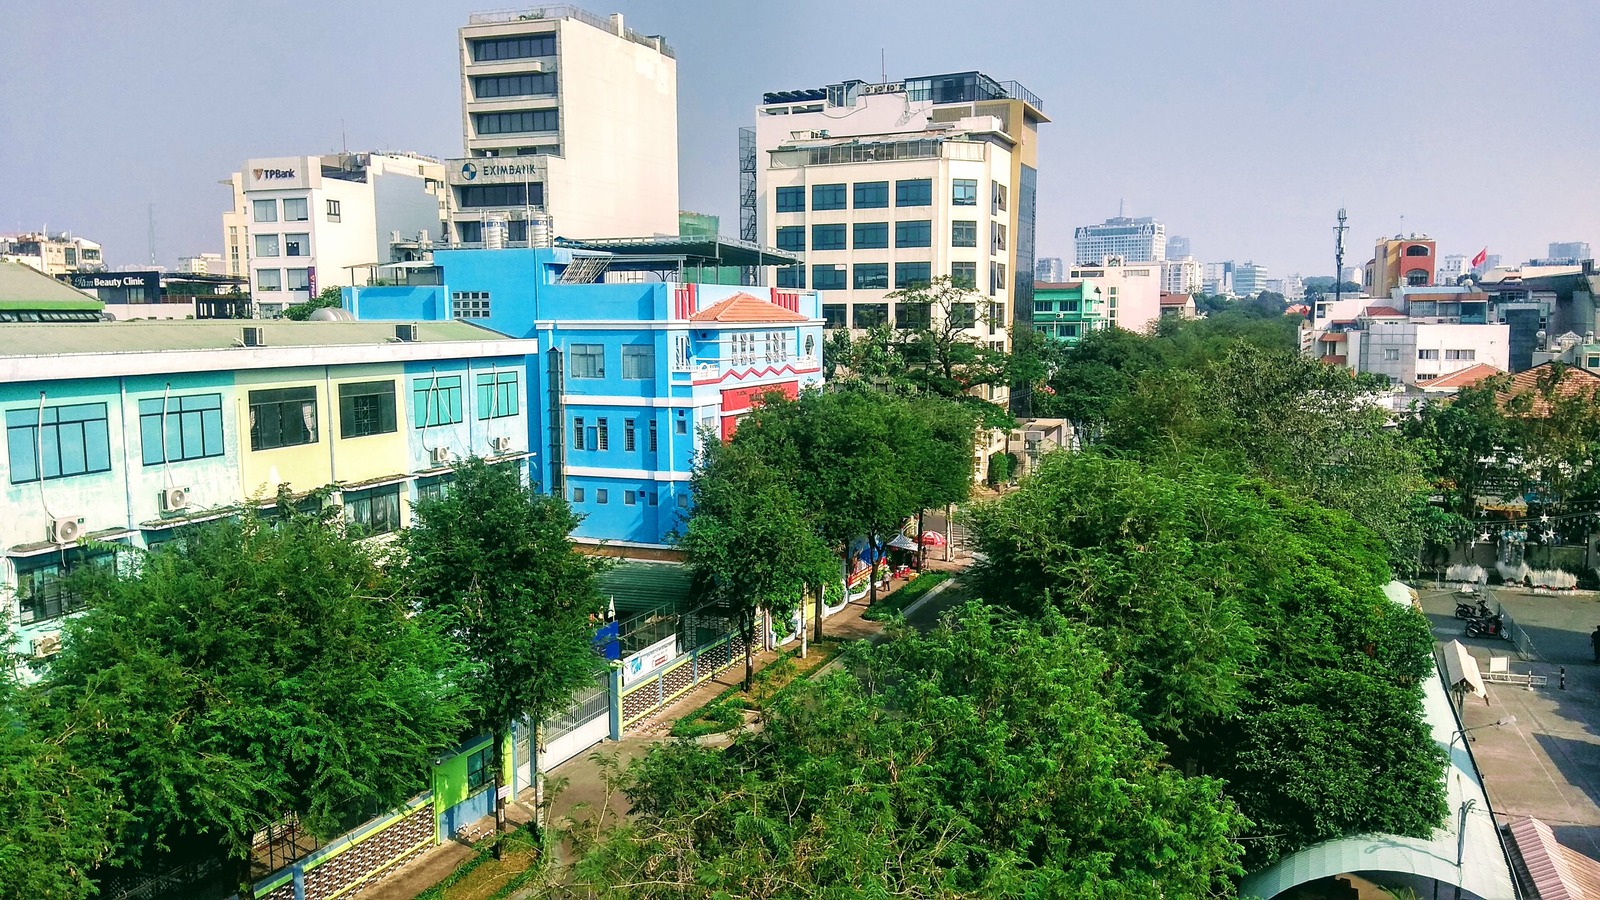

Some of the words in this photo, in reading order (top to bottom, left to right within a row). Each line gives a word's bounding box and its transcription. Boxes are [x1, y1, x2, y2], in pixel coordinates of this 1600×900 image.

[264, 168, 296, 179] TPBank
[483, 164, 536, 176] EXIMBANK
[94, 278, 121, 288] Beauty
[123, 276, 145, 286] Clinic
